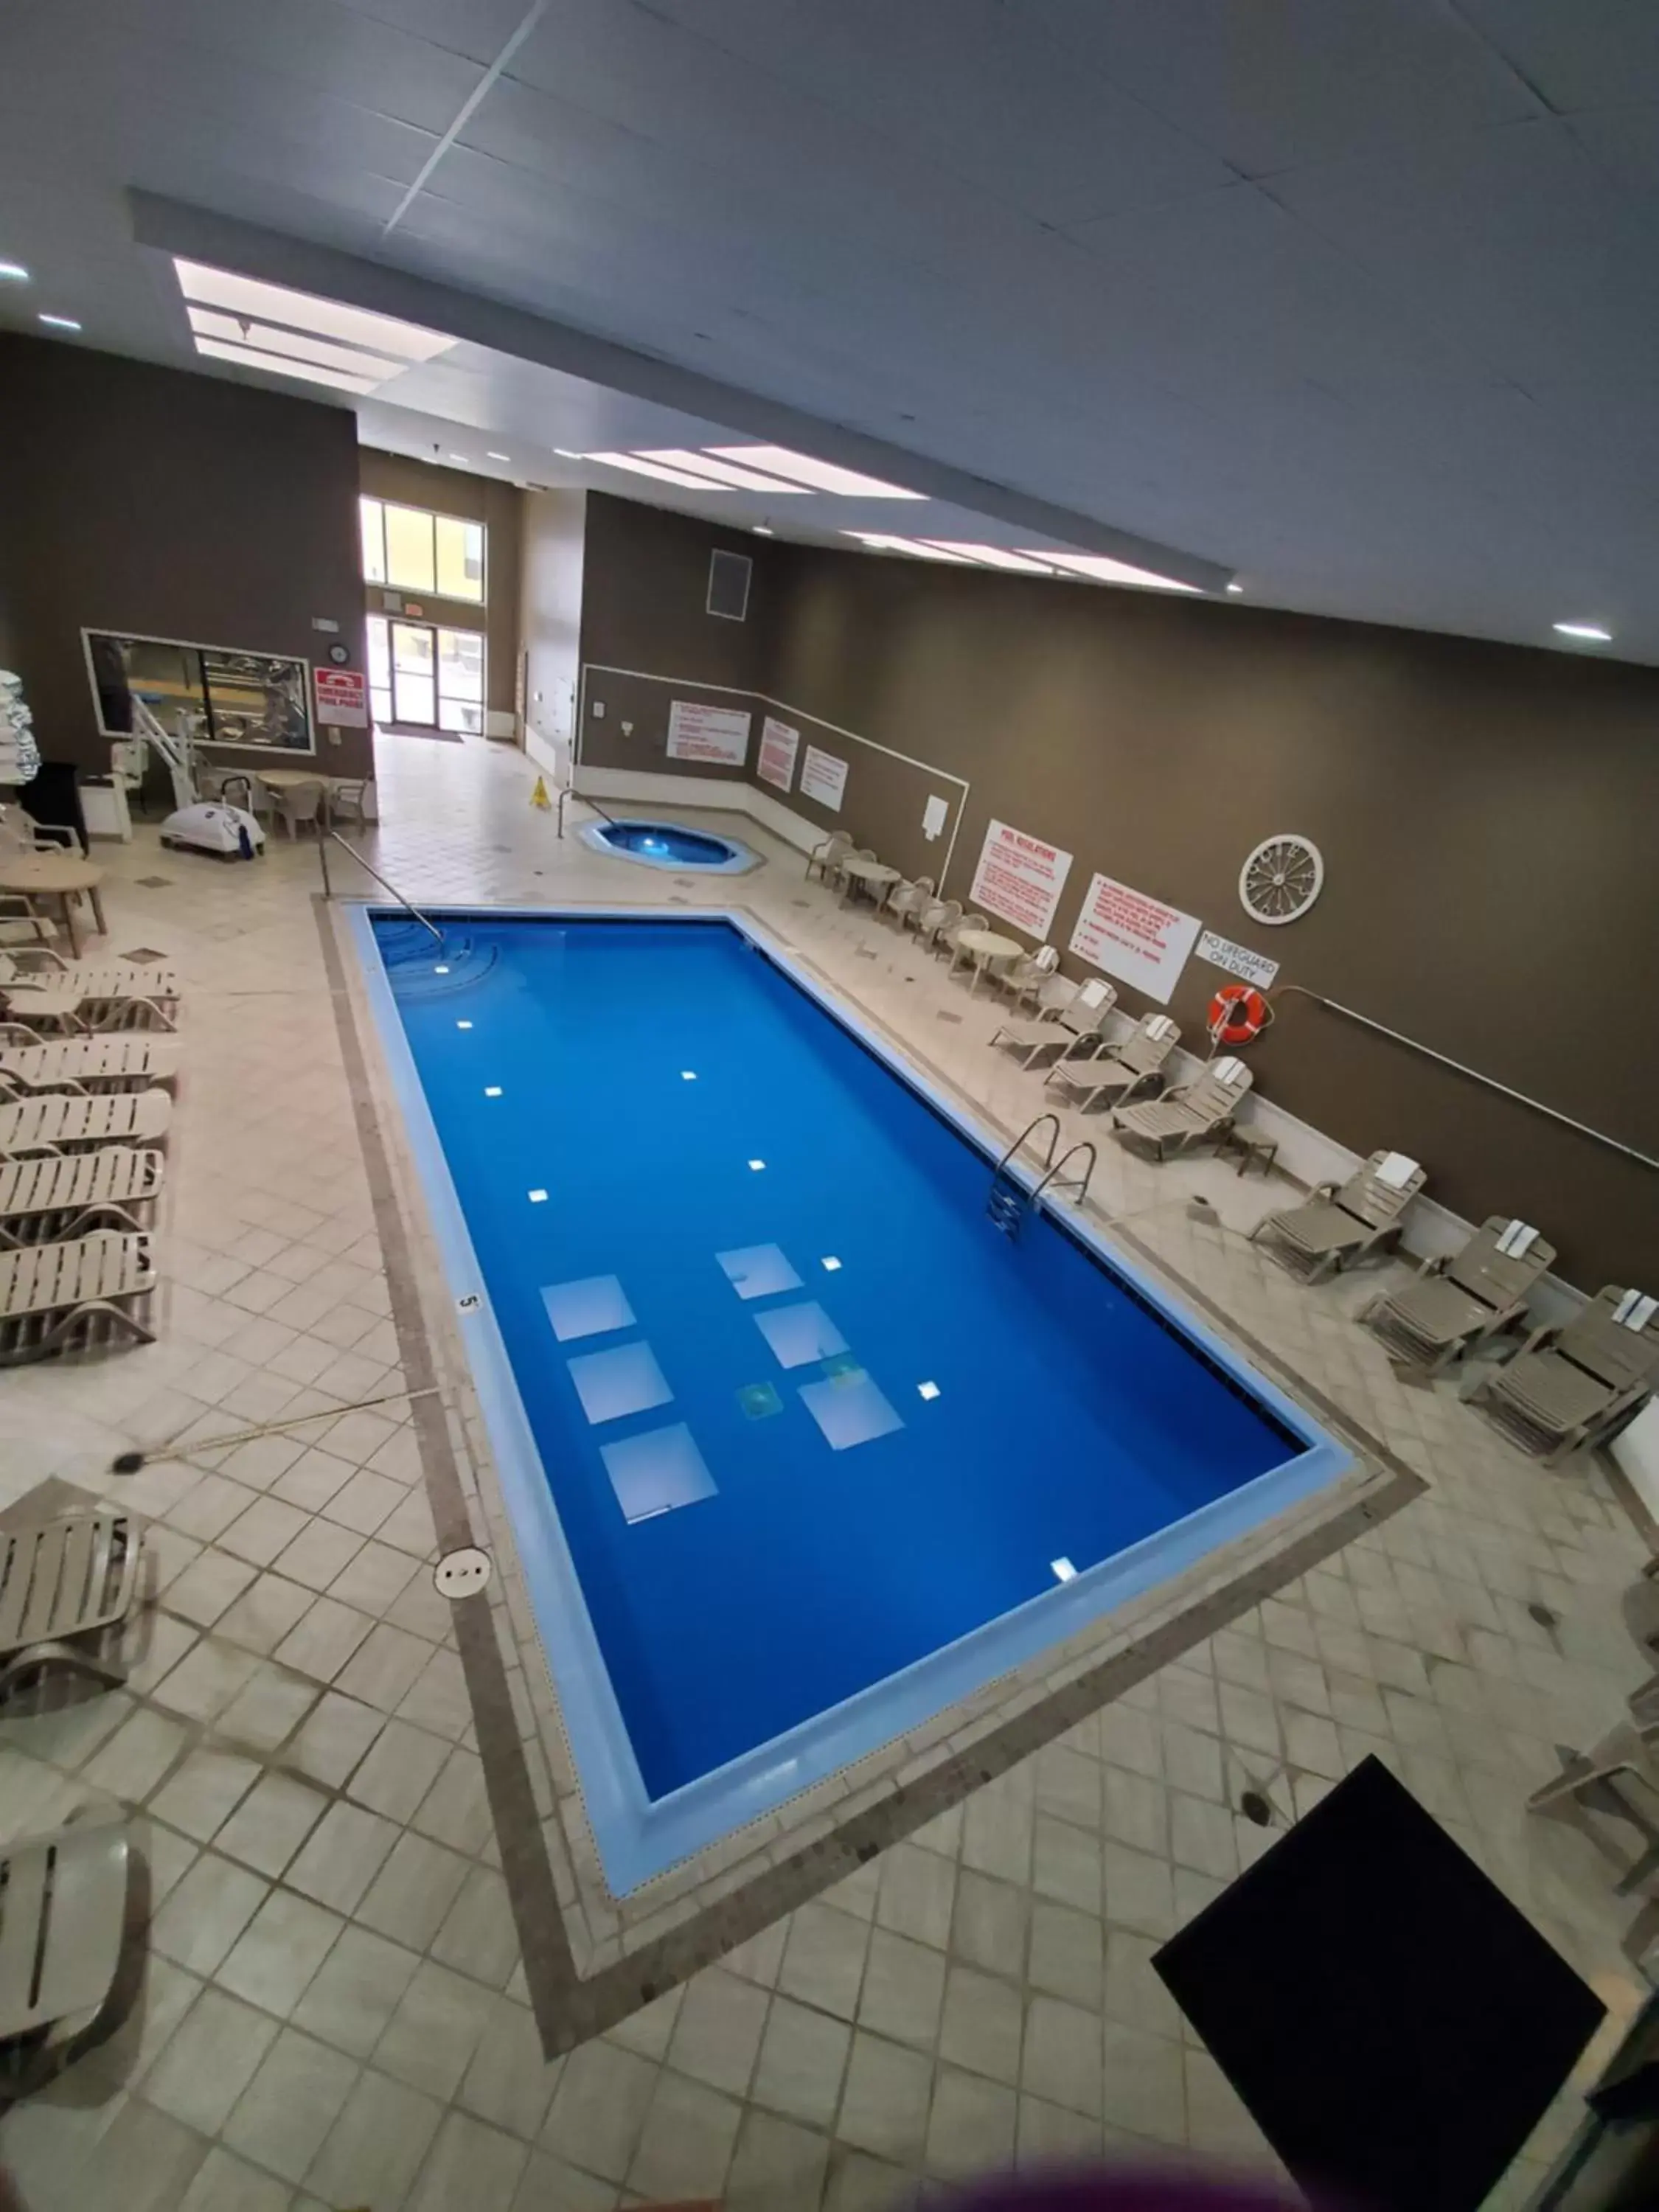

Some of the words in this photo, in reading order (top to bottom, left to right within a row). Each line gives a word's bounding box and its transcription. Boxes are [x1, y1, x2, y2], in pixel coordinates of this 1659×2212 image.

[1203, 933, 1220, 948] NO
[1221, 942, 1275, 974] LIFEGUARD
[1209, 950, 1228, 966] ON
[1230, 959, 1256, 979] DUTY
